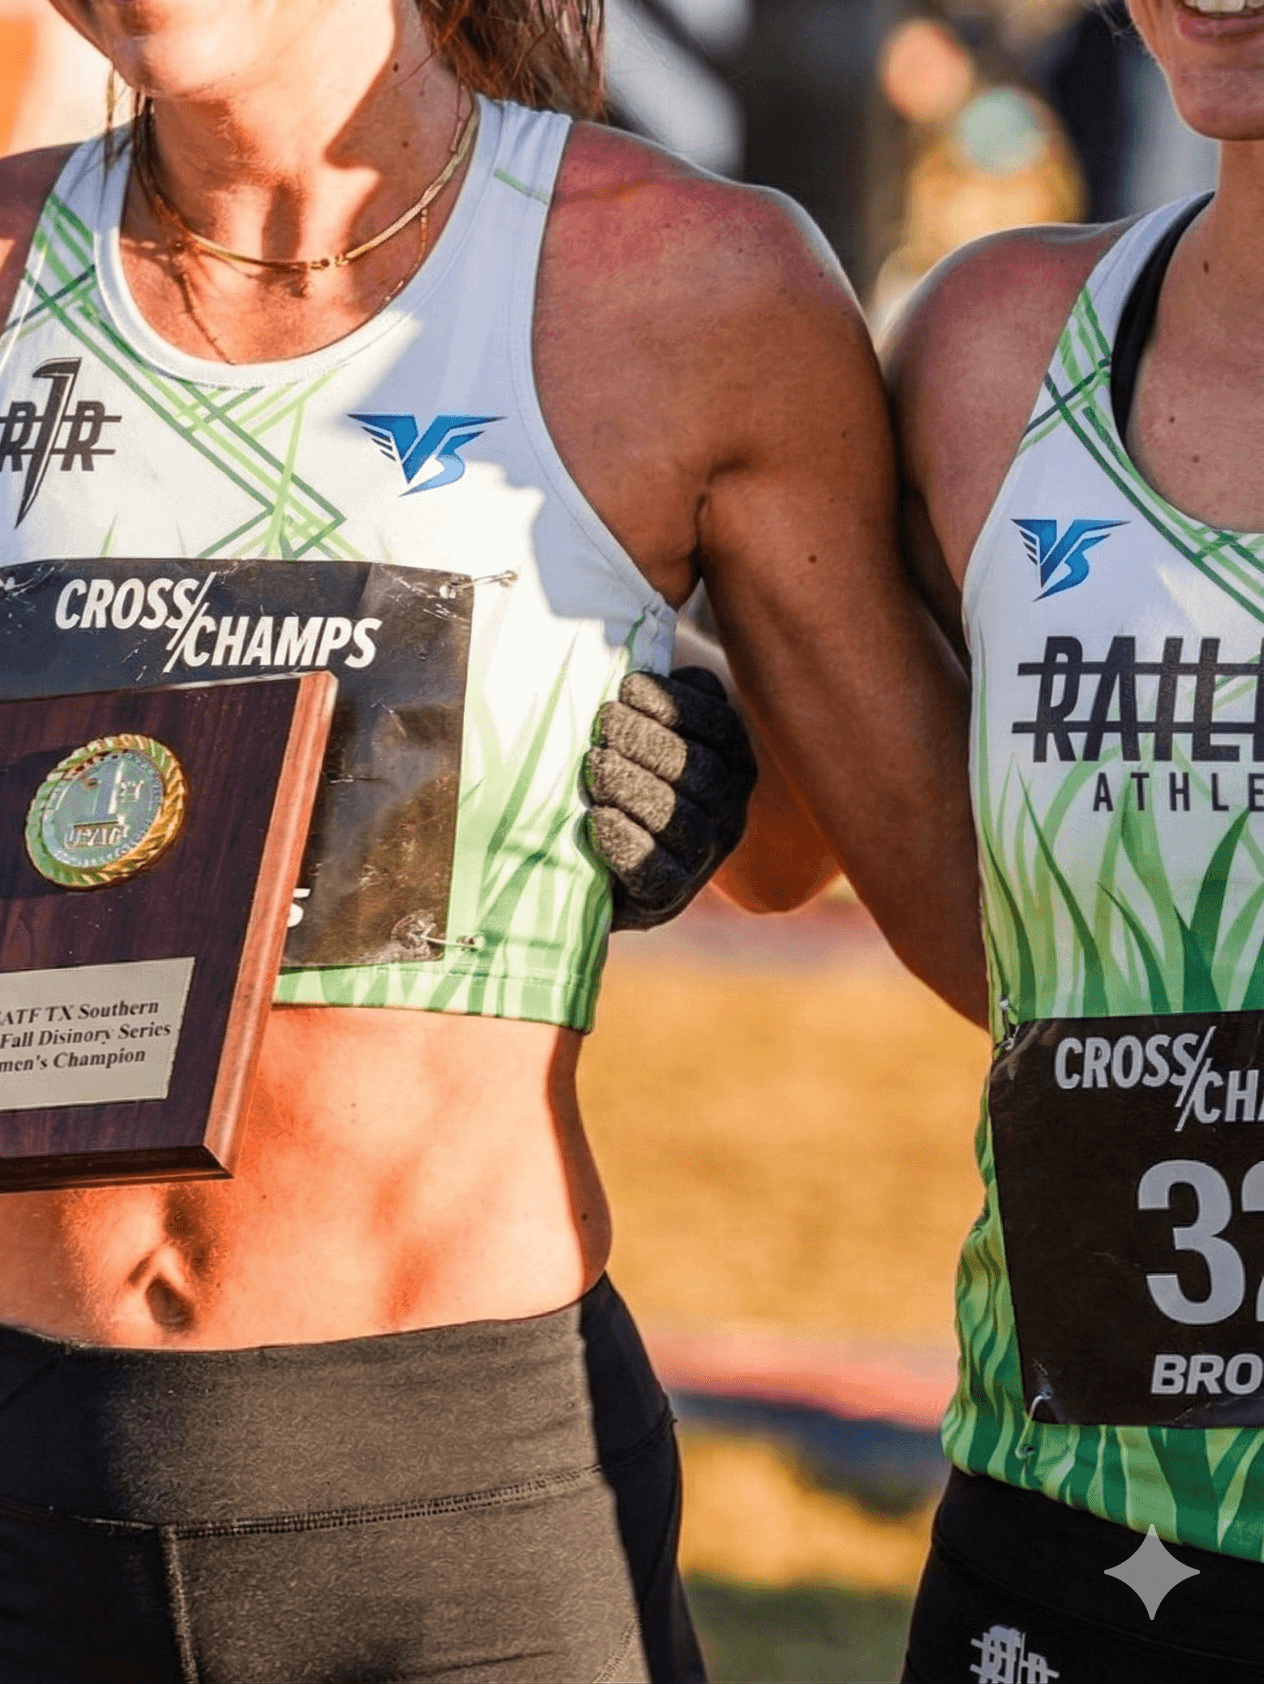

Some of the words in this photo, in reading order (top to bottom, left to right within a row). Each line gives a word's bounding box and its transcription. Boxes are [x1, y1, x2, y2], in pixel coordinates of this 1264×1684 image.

[1012, 635, 1264, 762] RAIL
[1093, 772, 1264, 812] ATHLE
[45, 1004, 75, 1022] TX
[78, 1000, 160, 1020] Southern
[0, 1031, 34, 1049] Fall
[118, 1021, 172, 1040] Series
[53, 1047, 146, 1069] Champion
[1192, 1068, 1264, 1124] CH
[1138, 1159, 1264, 1326] 3
[1151, 1352, 1264, 1395] BRO
